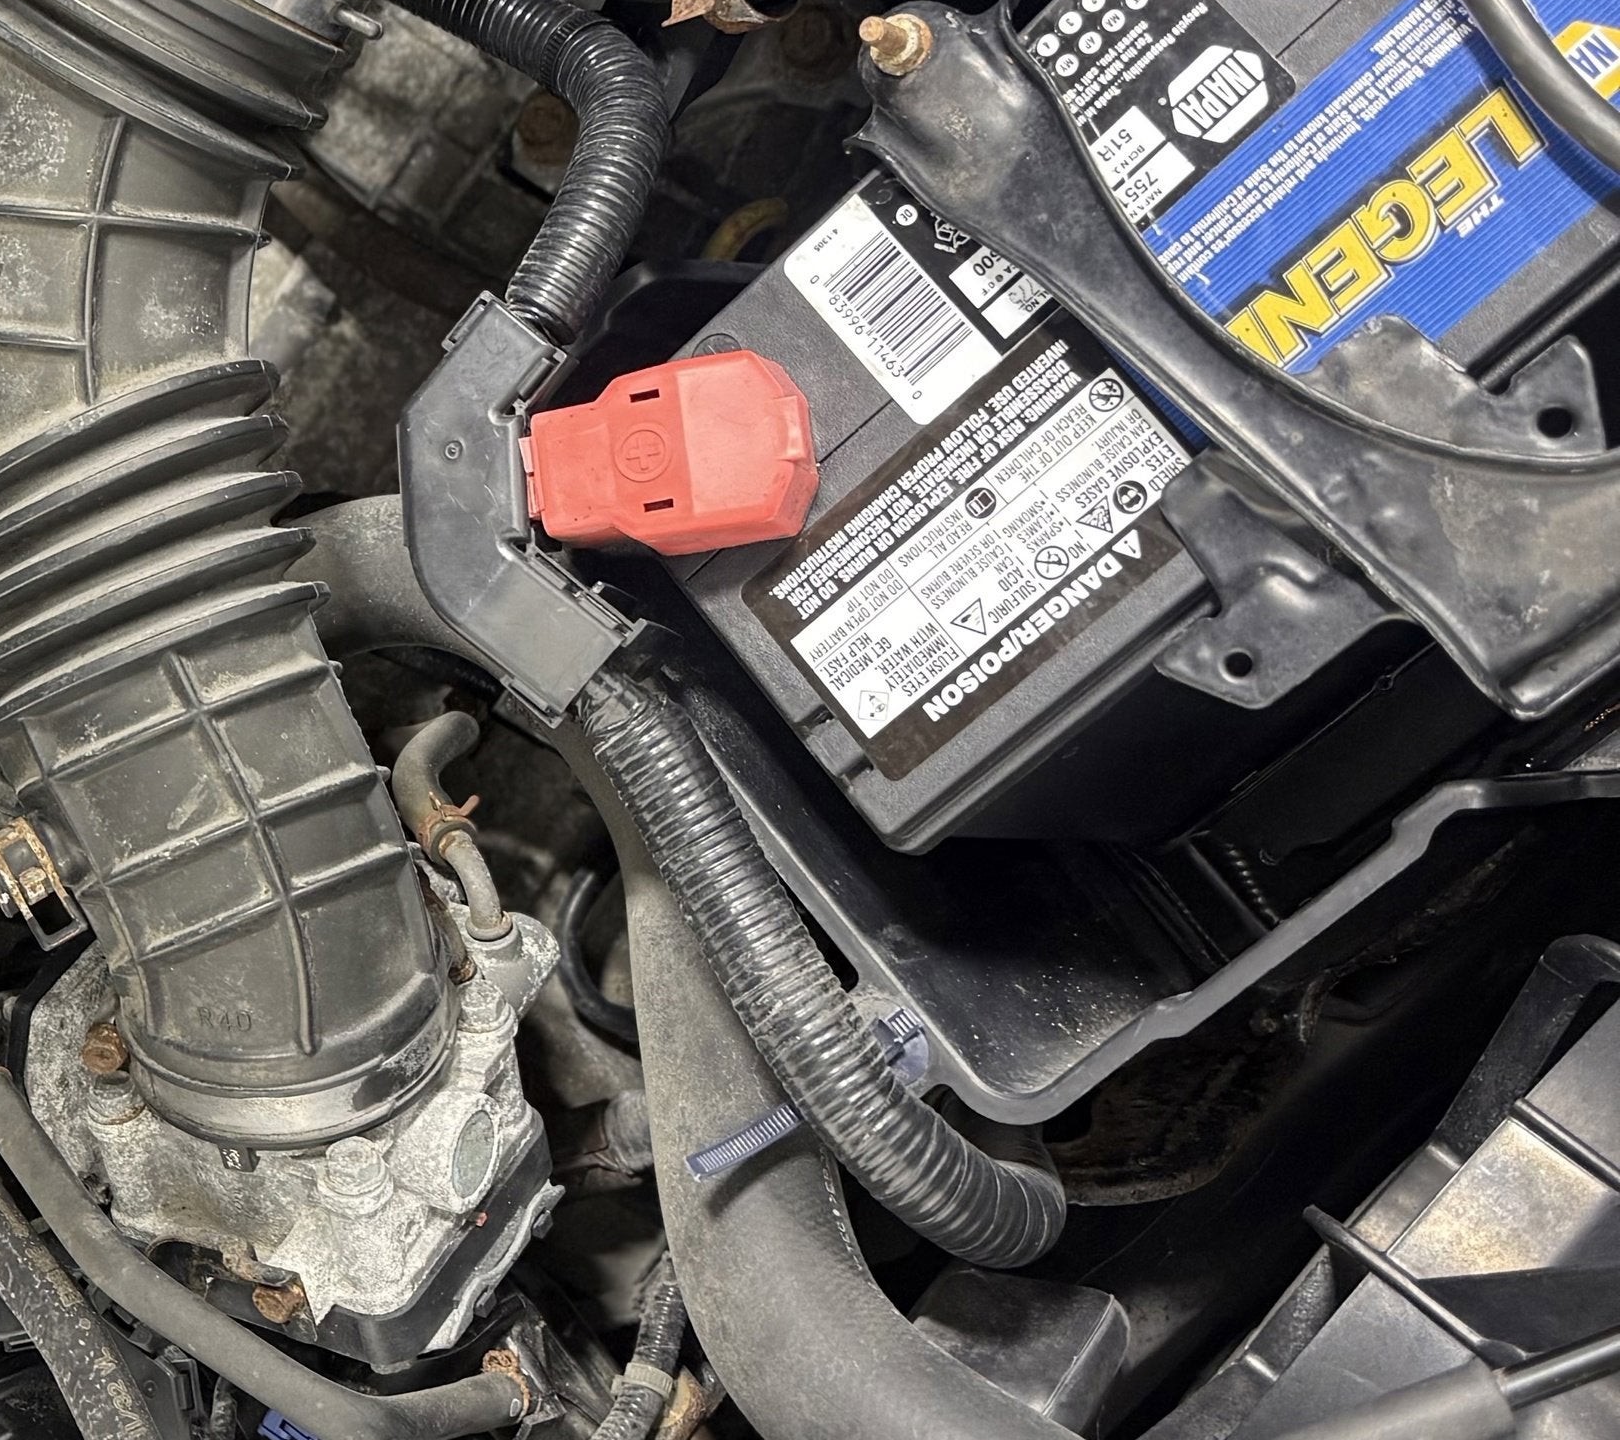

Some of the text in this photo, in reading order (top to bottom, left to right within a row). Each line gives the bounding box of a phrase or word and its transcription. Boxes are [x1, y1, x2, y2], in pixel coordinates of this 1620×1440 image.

[1104, 13, 1120, 28] MA
[1169, 0, 1209, 38] Recycle
[1395, 17, 1435, 54] contain
[1079, 18, 1150, 86] nearest you, call
[1082, 36, 1096, 50] AP
[1404, 14, 1457, 64] chemicals
[1058, 57, 1074, 72] MY
[1073, 31, 1154, 107] For the NAPA AUTO
[1370, 48, 1400, 76] other
[1374, 58, 1409, 91] known
[1384, 62, 1424, 100] Battery
[1176, 55, 1256, 133] NAPA
[1322, 70, 1376, 120] chemicals
[1348, 95, 1368, 115] the
[1364, 85, 1379, 101] to
[1292, 112, 1328, 145] known
[1311, 131, 1328, 147] of
[1312, 118, 1361, 164] terminals
[1322, 108, 1352, 138] State
[1096, 127, 1133, 163] 51R
[1267, 148, 1288, 168] the
[1268, 139, 1317, 185] California
[1282, 138, 1298, 154] to
[1242, 162, 1272, 191] State
[1257, 180, 1273, 195] to
[1293, 158, 1318, 182] and
[1230, 185, 1246, 201] of
[1230, 189, 1261, 219] cause
[1261, 173, 1300, 210] related
[898, 207, 913, 222] DE
[1189, 194, 1237, 239] California
[1199, 213, 1235, 246] cancer
[1209, 202, 1267, 256] accessories
[1452, 191, 1504, 239] THE
[1179, 232, 1195, 247] to
[1183, 240, 1205, 262] and
[1176, 249, 1215, 285] contain
[1022, 298, 1039, 314] NO.
[827, 292, 867, 337] 83996
[865, 335, 906, 379] 11463
[993, 402, 1086, 485] REACH OF CHILDREN
[1017, 413, 1096, 483] KEEP OUT OF THE
[1090, 407, 1141, 453] OR INJURY.
[767, 338, 1069, 603] INVERTED USE. FOLLOW PROPER CHARGING INSTRUCTIONS.
[1053, 418, 1151, 503] CAN CAUSE BLINDNESS
[1073, 430, 1163, 509] EXPLOSIVE GASES
[1140, 443, 1175, 475] EYES.
[1147, 455, 1187, 493] SHIELD
[786, 358, 1071, 607] DISASSEMBLE OR INCINERATE. NOT RECOMMENDED FOR
[794, 369, 1082, 620] WARNING: RISK OF FIRE, EXPLOSION OR BURNS. DO NOT
[927, 519, 972, 560] READ ALL
[1066, 539, 1086, 559] NO
[858, 567, 893, 600] DO NOT
[919, 532, 995, 599] OR SEVERE BURNS
[929, 543, 1004, 610] CAUSE BLINDNESS
[992, 554, 1014, 575] CAN
[996, 566, 1024, 592] ACID
[806, 578, 903, 662] DO NOT OPEN BATTERY
[986, 578, 1037, 624] SULFURIC
[819, 632, 872, 679] HELP FAST.
[873, 621, 938, 678] WITH WATER.
[920, 550, 1122, 723] DANGER/POISON
[828, 635, 892, 692] GET MEDICAL
[883, 633, 948, 690] IMMEDIATELY
[900, 646, 959, 697] FLUSH EYES
